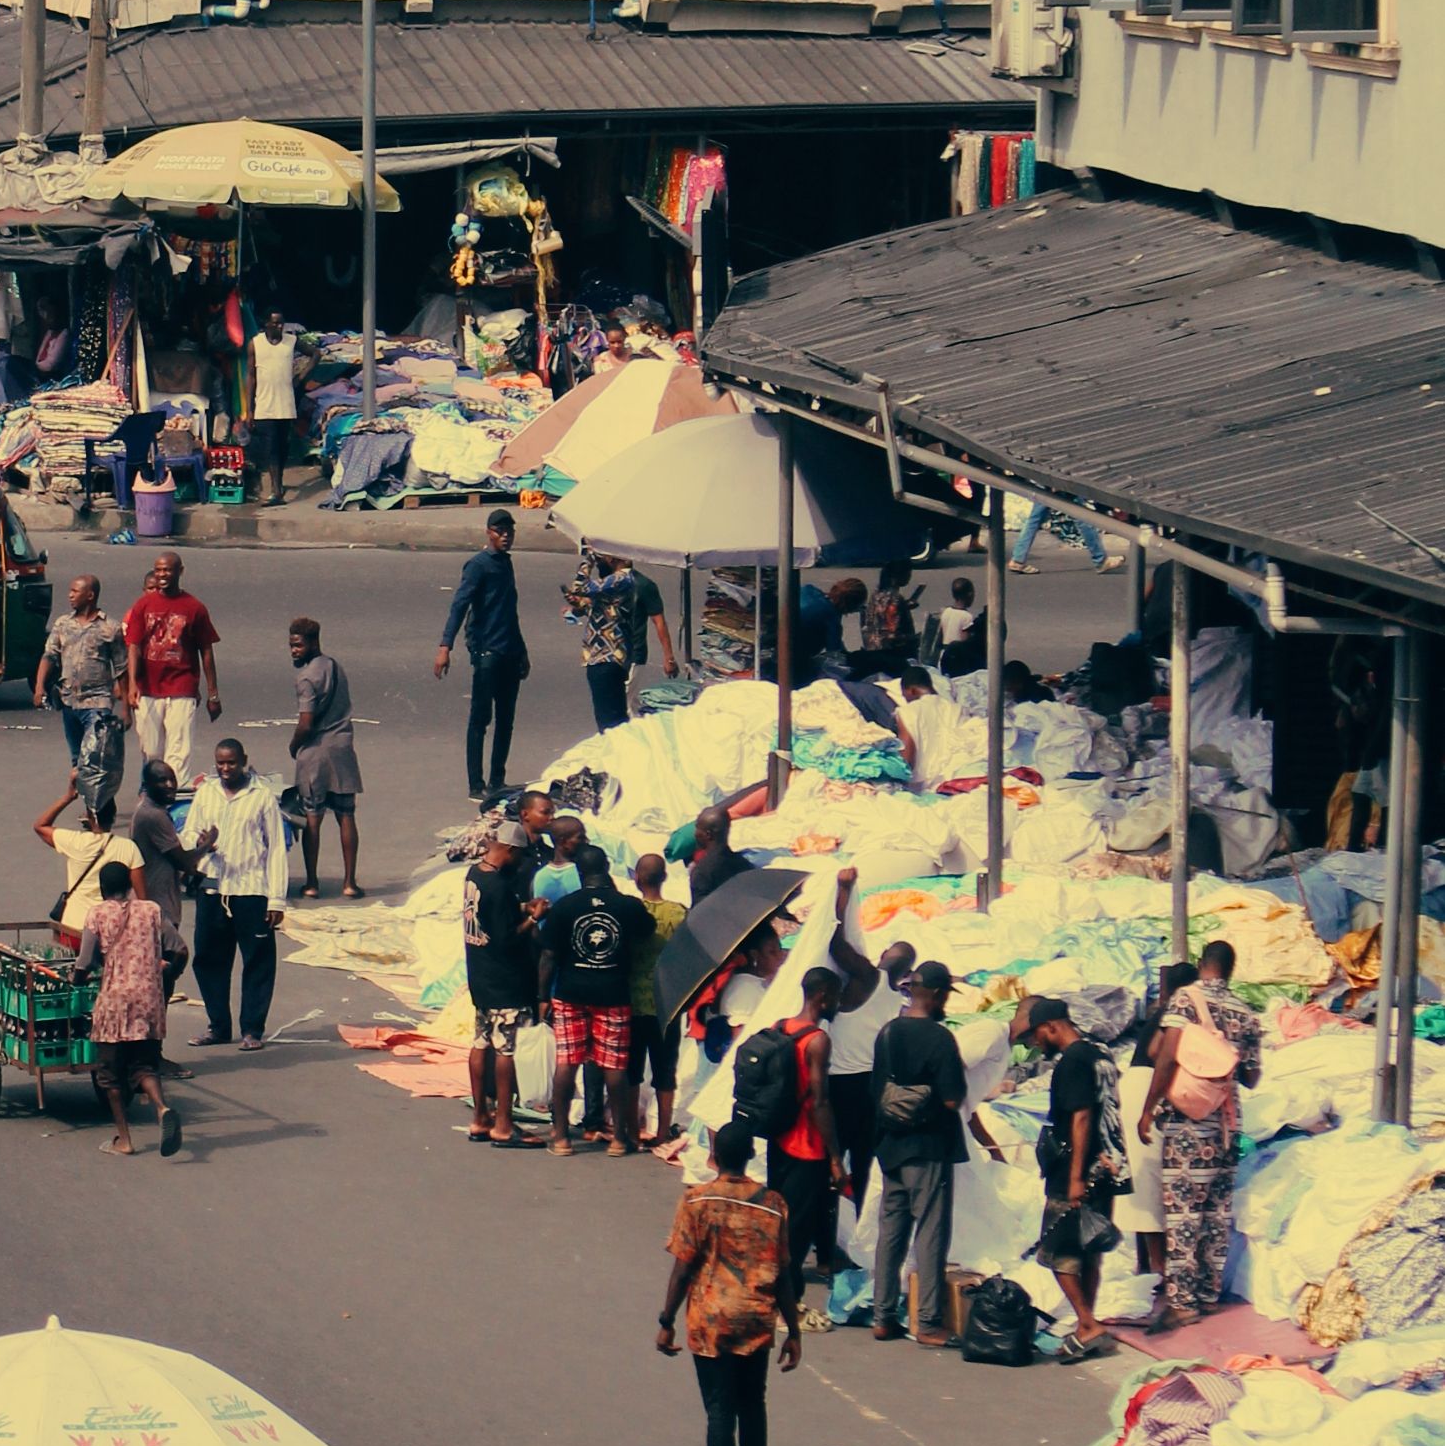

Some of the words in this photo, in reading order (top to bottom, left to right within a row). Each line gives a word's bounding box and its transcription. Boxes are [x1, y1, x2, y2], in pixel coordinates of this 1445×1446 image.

[158, 155, 193, 163] MORE
[194, 155, 226, 163] DATA
[154, 163, 185, 171] MORE
[85, 1405, 163, 1430] Emily
